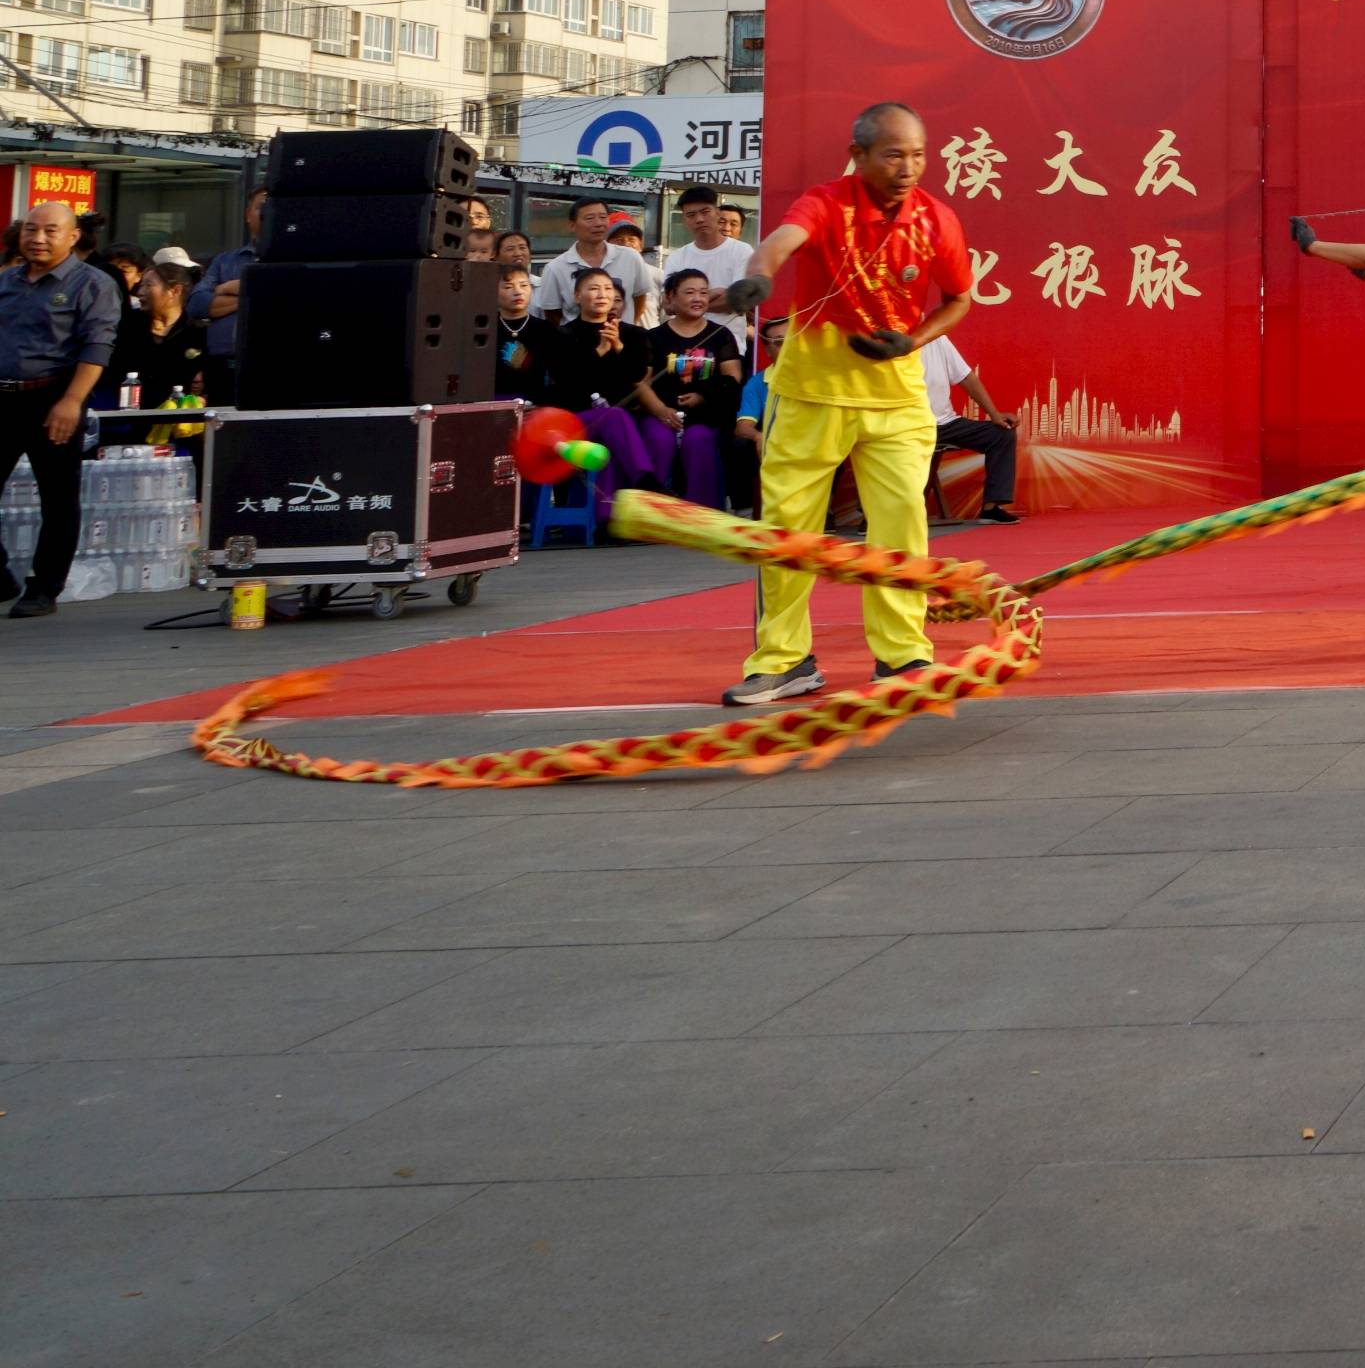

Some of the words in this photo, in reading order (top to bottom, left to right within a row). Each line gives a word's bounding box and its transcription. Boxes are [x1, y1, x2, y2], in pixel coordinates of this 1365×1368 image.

[843, 127, 1197, 200] 续大众
[34, 171, 92, 195] 爆炒刀削
[683, 170, 746, 184] HENAN
[236, 497, 283, 513] 大睿
[346, 494, 393, 511] 音频
[288, 504, 311, 512] DARE
[314, 504, 341, 512] AUDIO
